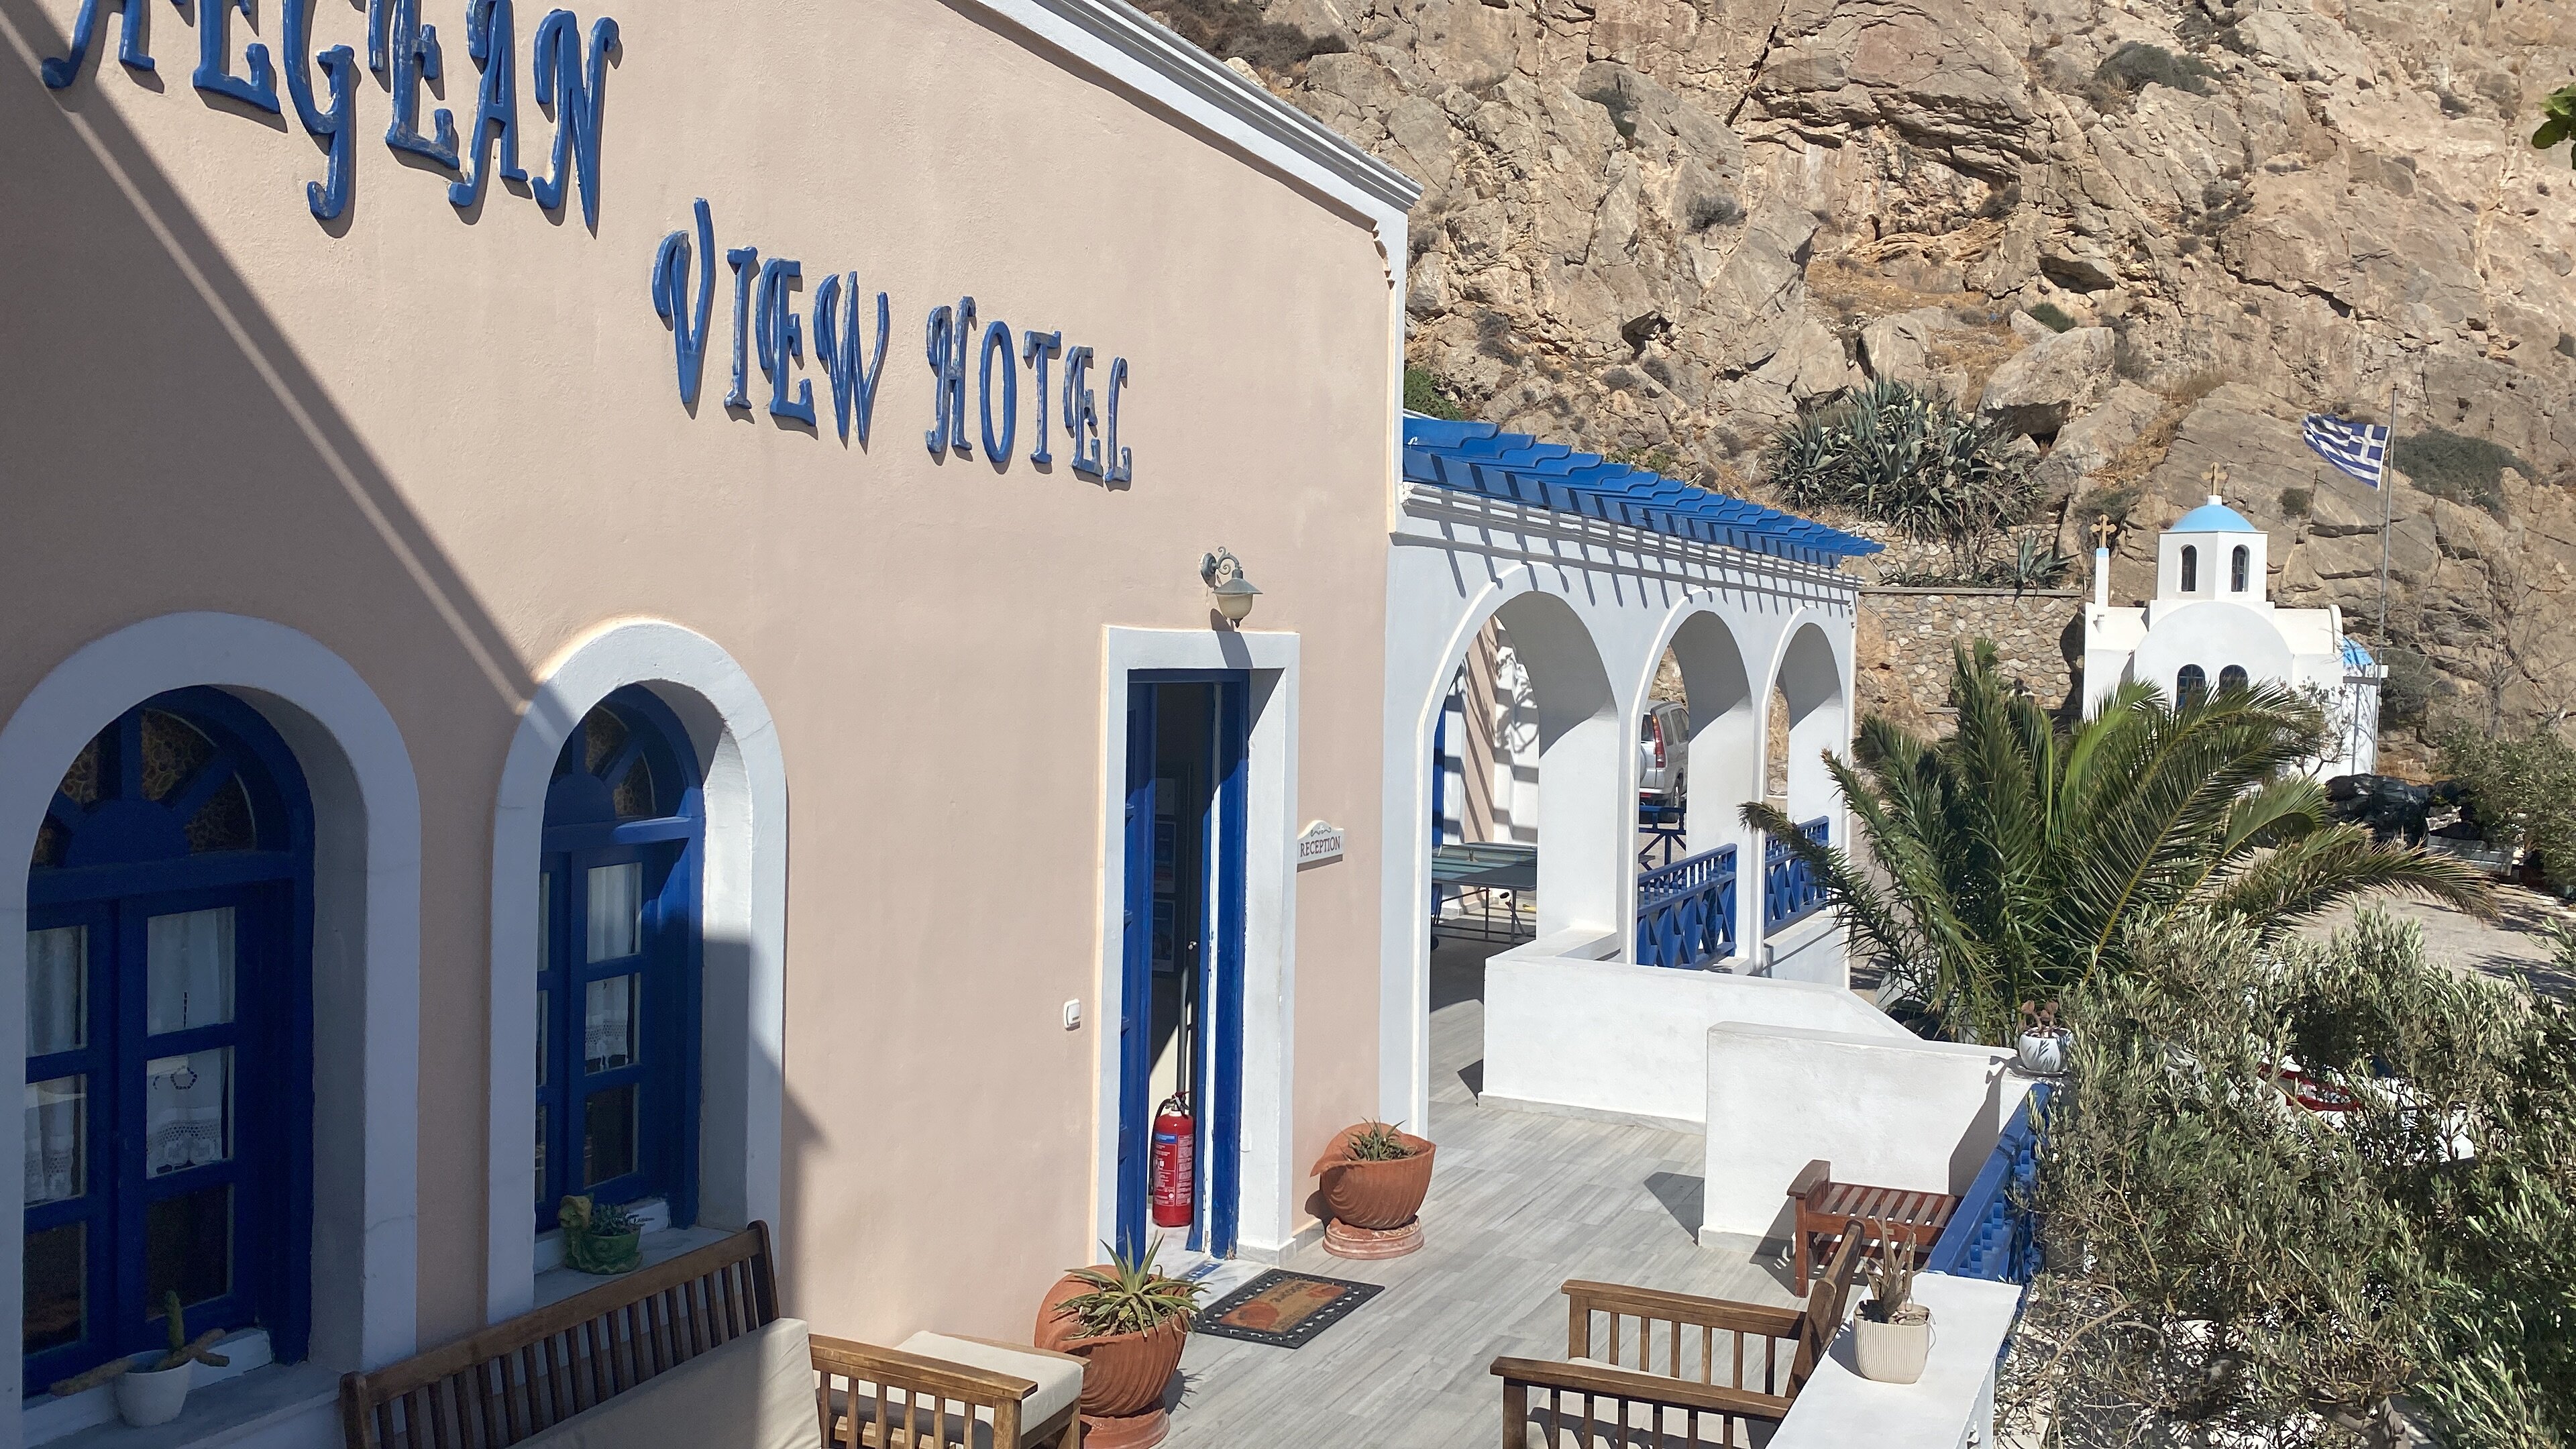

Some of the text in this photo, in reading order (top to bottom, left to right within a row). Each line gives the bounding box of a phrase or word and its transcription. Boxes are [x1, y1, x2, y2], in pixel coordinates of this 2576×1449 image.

[652, 197, 1132, 483] VIEW HOTEL
[1300, 836, 1340, 857] RECEPTION
